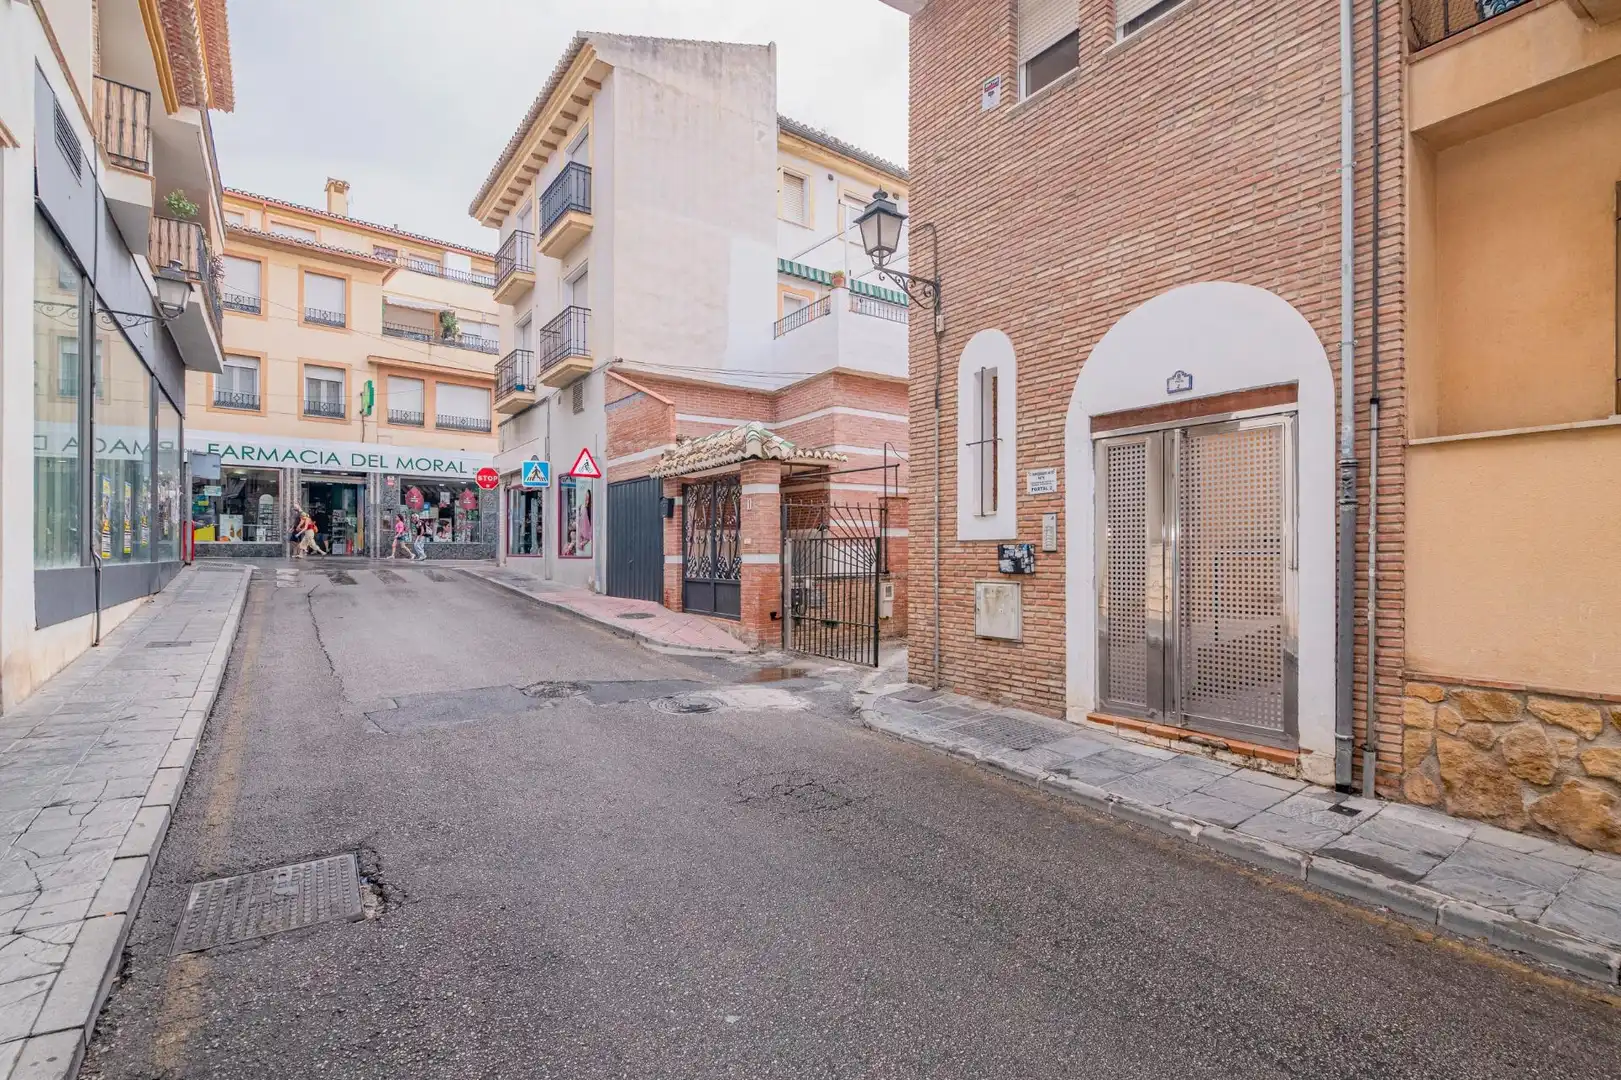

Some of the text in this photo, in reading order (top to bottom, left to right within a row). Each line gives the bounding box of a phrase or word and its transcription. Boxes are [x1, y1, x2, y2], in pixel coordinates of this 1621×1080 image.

[207, 442, 341, 465] FARMACIA
[351, 453, 388, 468] DEL
[396, 457, 467, 473] MORAL
